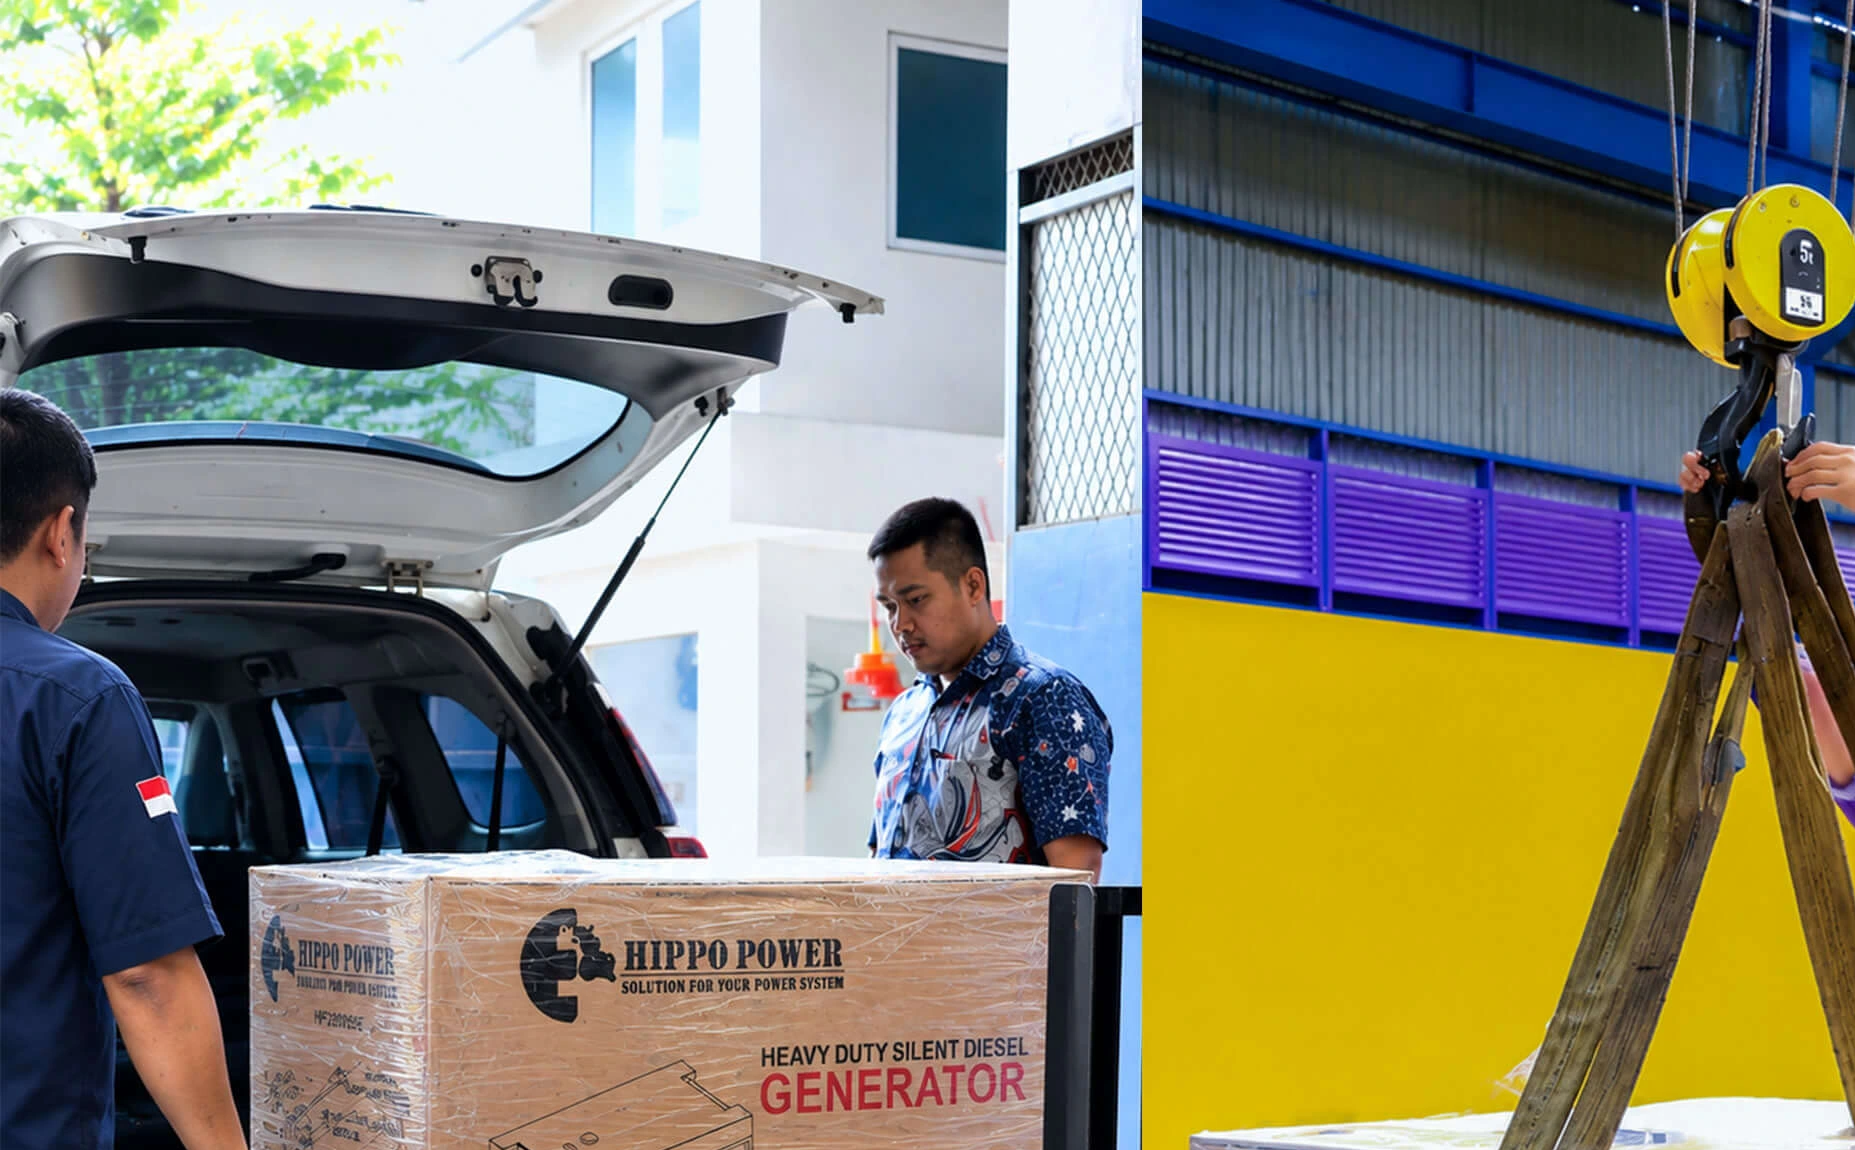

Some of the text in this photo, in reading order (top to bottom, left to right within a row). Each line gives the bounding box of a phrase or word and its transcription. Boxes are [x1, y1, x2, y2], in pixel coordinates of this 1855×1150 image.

[298, 939, 395, 975] HIPPO POWER
[624, 938, 843, 971] HIPPO POWER
[621, 975, 845, 994] SOLUTION FOR YOUR POWER SYSTEM
[761, 1036, 1029, 1067] HEAVY DUTY SILENT DIESEL
[760, 1061, 1026, 1115] GENERATOR
